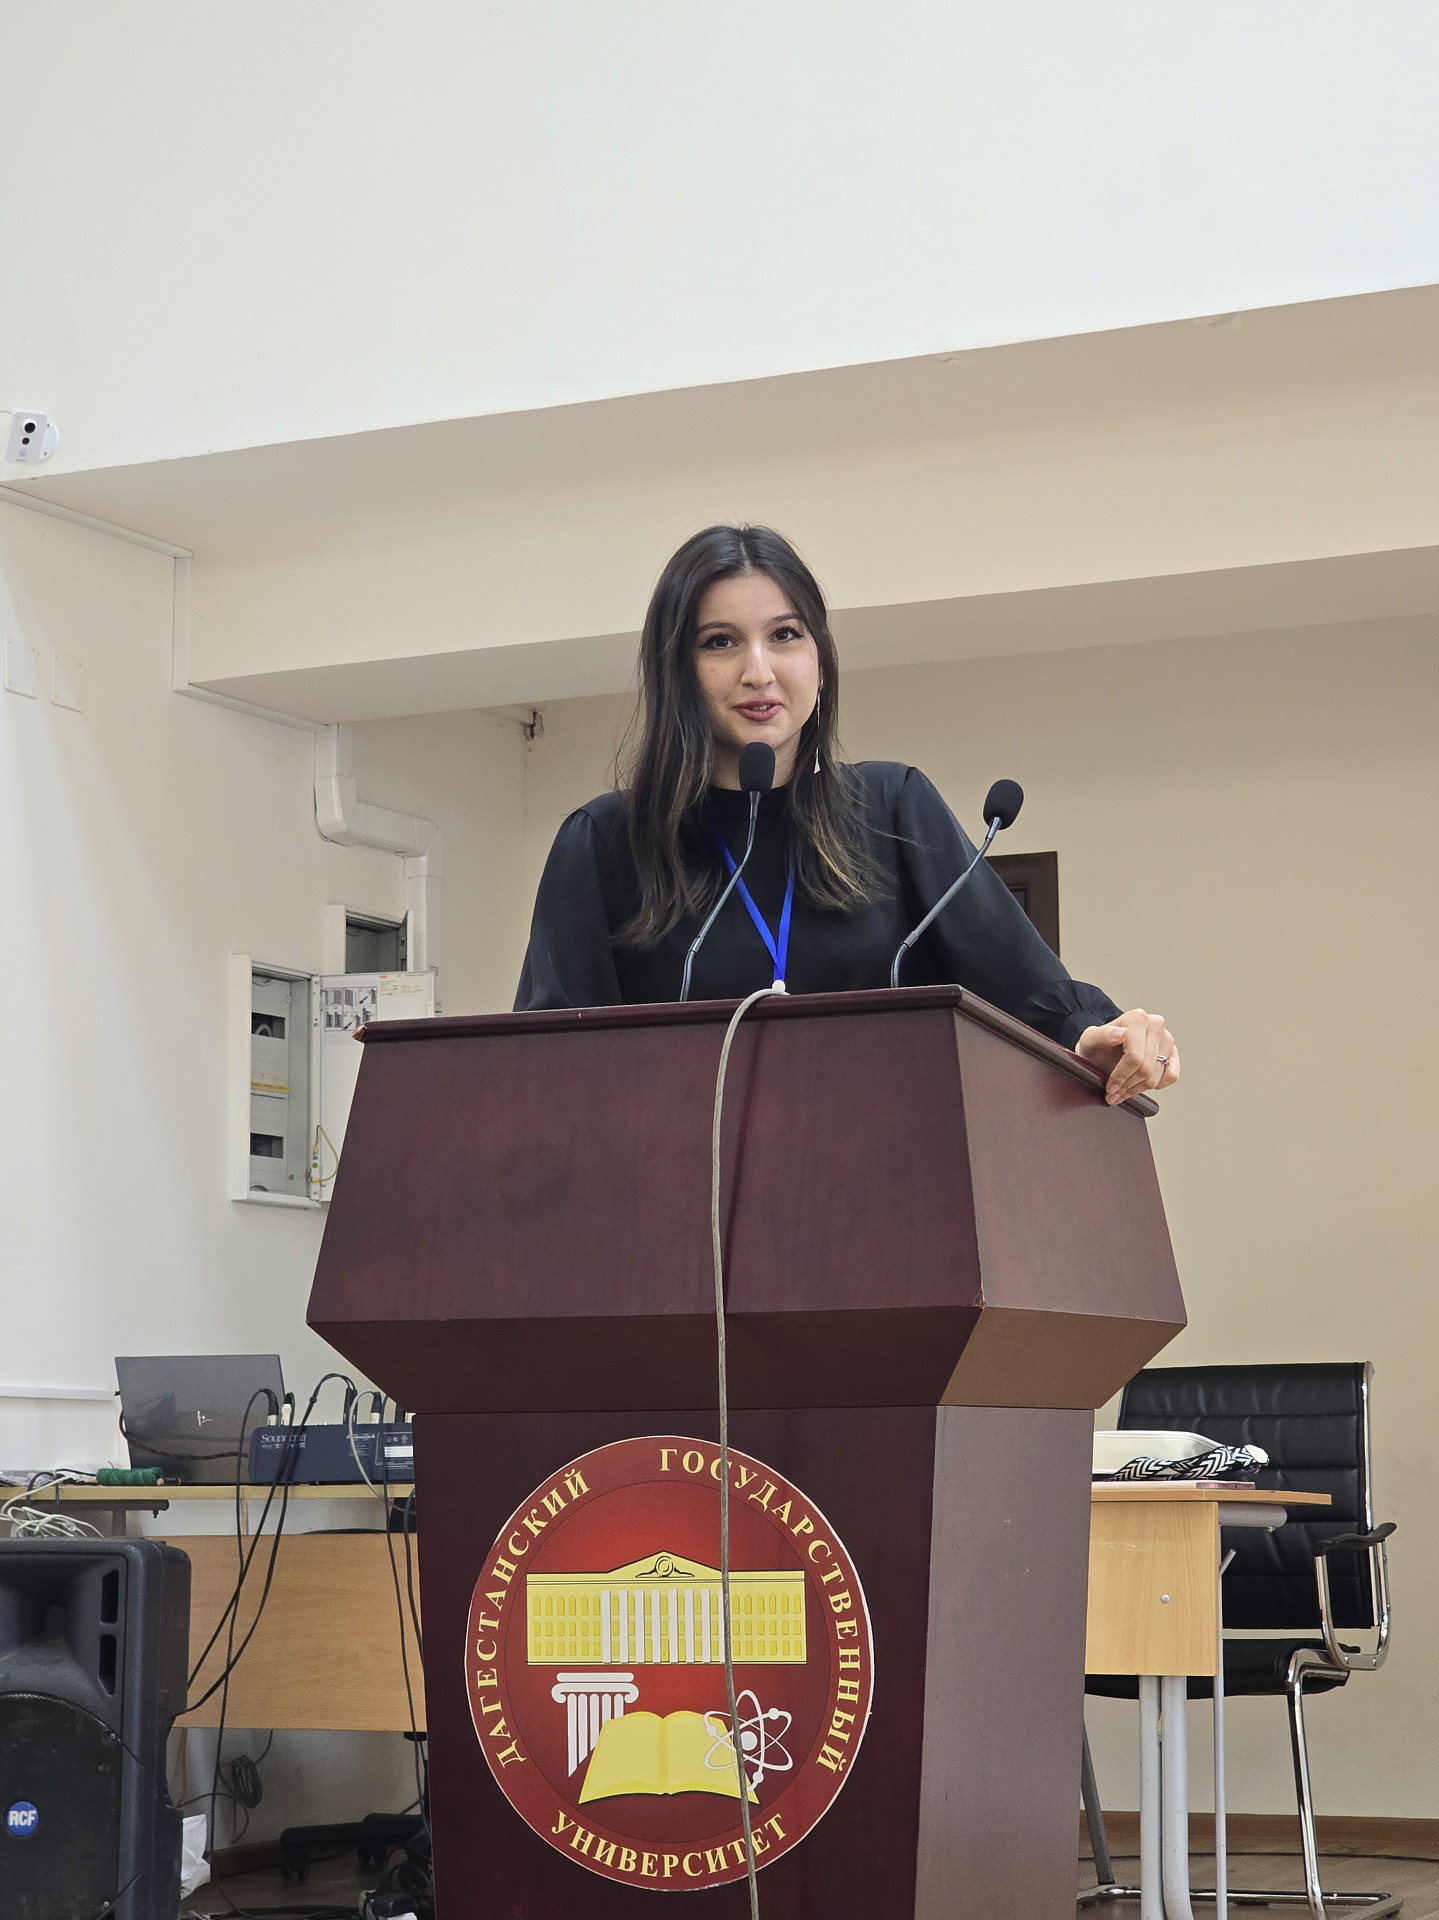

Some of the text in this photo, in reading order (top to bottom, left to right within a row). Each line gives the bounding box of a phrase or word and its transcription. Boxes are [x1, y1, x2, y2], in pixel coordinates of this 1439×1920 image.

[477, 1448, 861, 1774] ДАГЕСТАНСКИЙ ГОСУДАРСТВЕННЫЙ
[9, 1810, 37, 1826] RCF
[551, 1810, 788, 1878] УНИВЕРСИТЕТ
